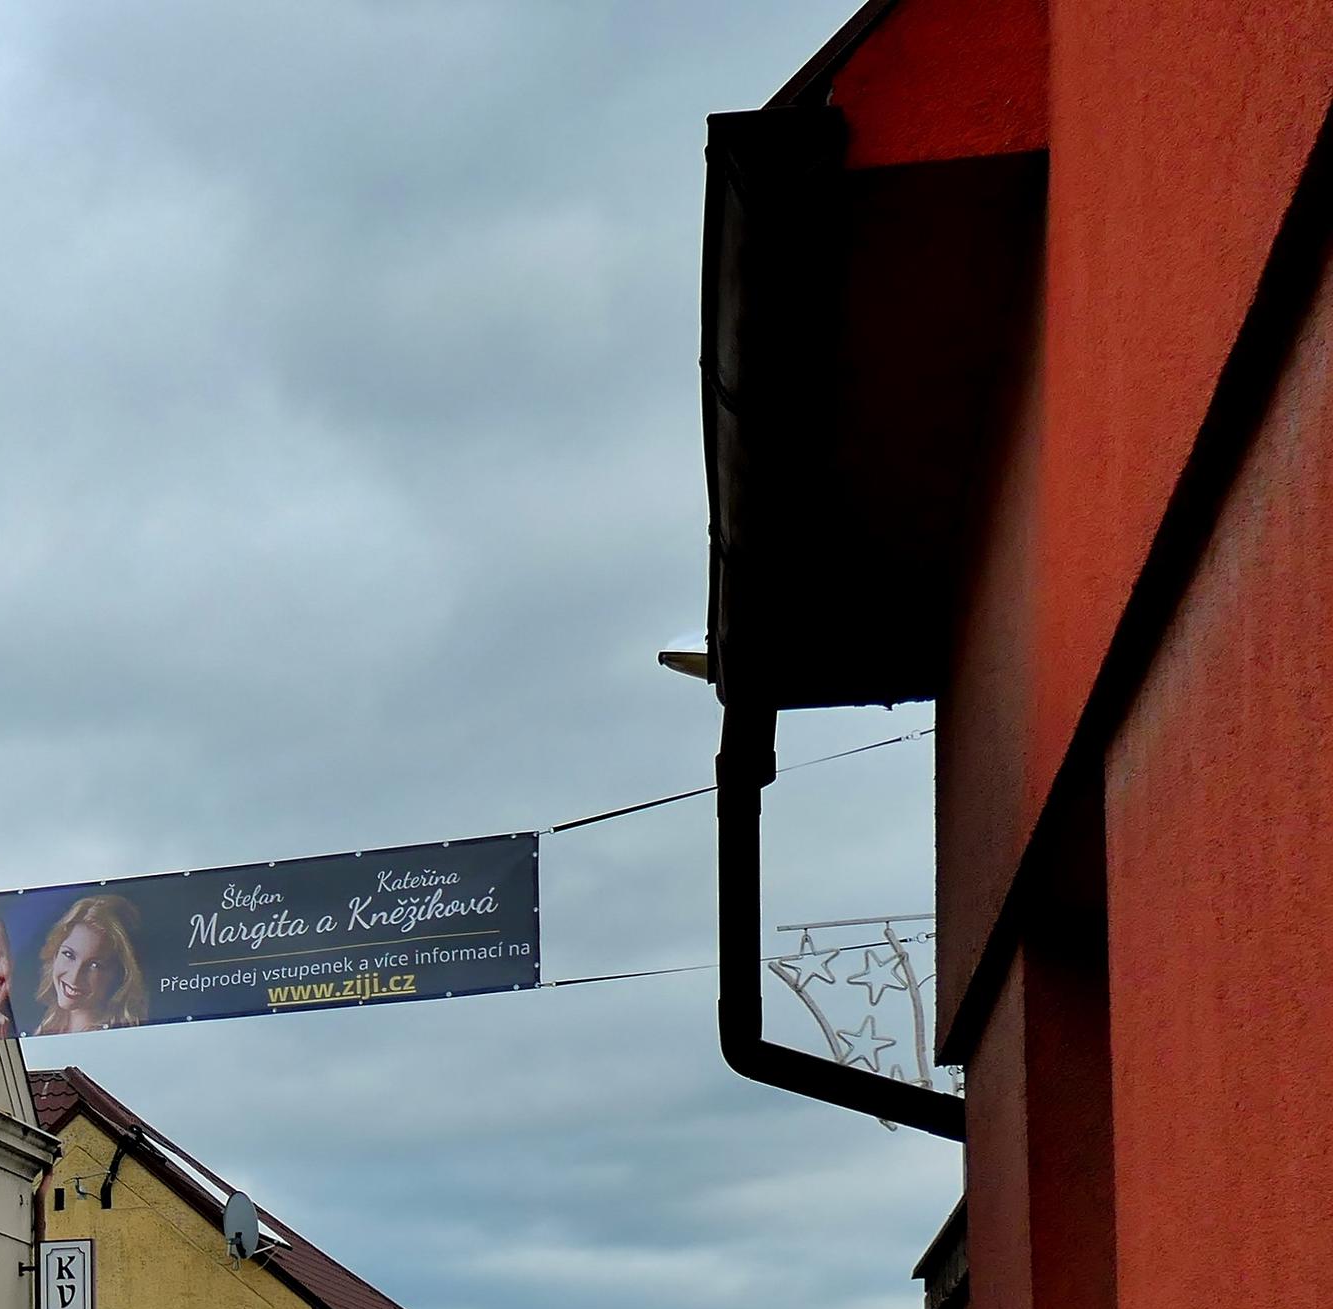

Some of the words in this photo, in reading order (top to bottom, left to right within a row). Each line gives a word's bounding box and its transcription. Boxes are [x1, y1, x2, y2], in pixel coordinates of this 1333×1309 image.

[377, 869, 461, 893] Kateřina
[221, 883, 284, 911] Štefan
[187, 909, 310, 950] Margita
[316, 915, 338, 933] a
[347, 887, 499, 933] Kněžíková
[160, 967, 257, 992] Předprodej
[262, 957, 353, 980] vstupenek
[359, 959, 369, 970] a
[374, 952, 409, 968] více
[415, 941, 503, 965] informací
[509, 942, 530, 956] na
[267, 972, 416, 1003] www.ziji.cz
